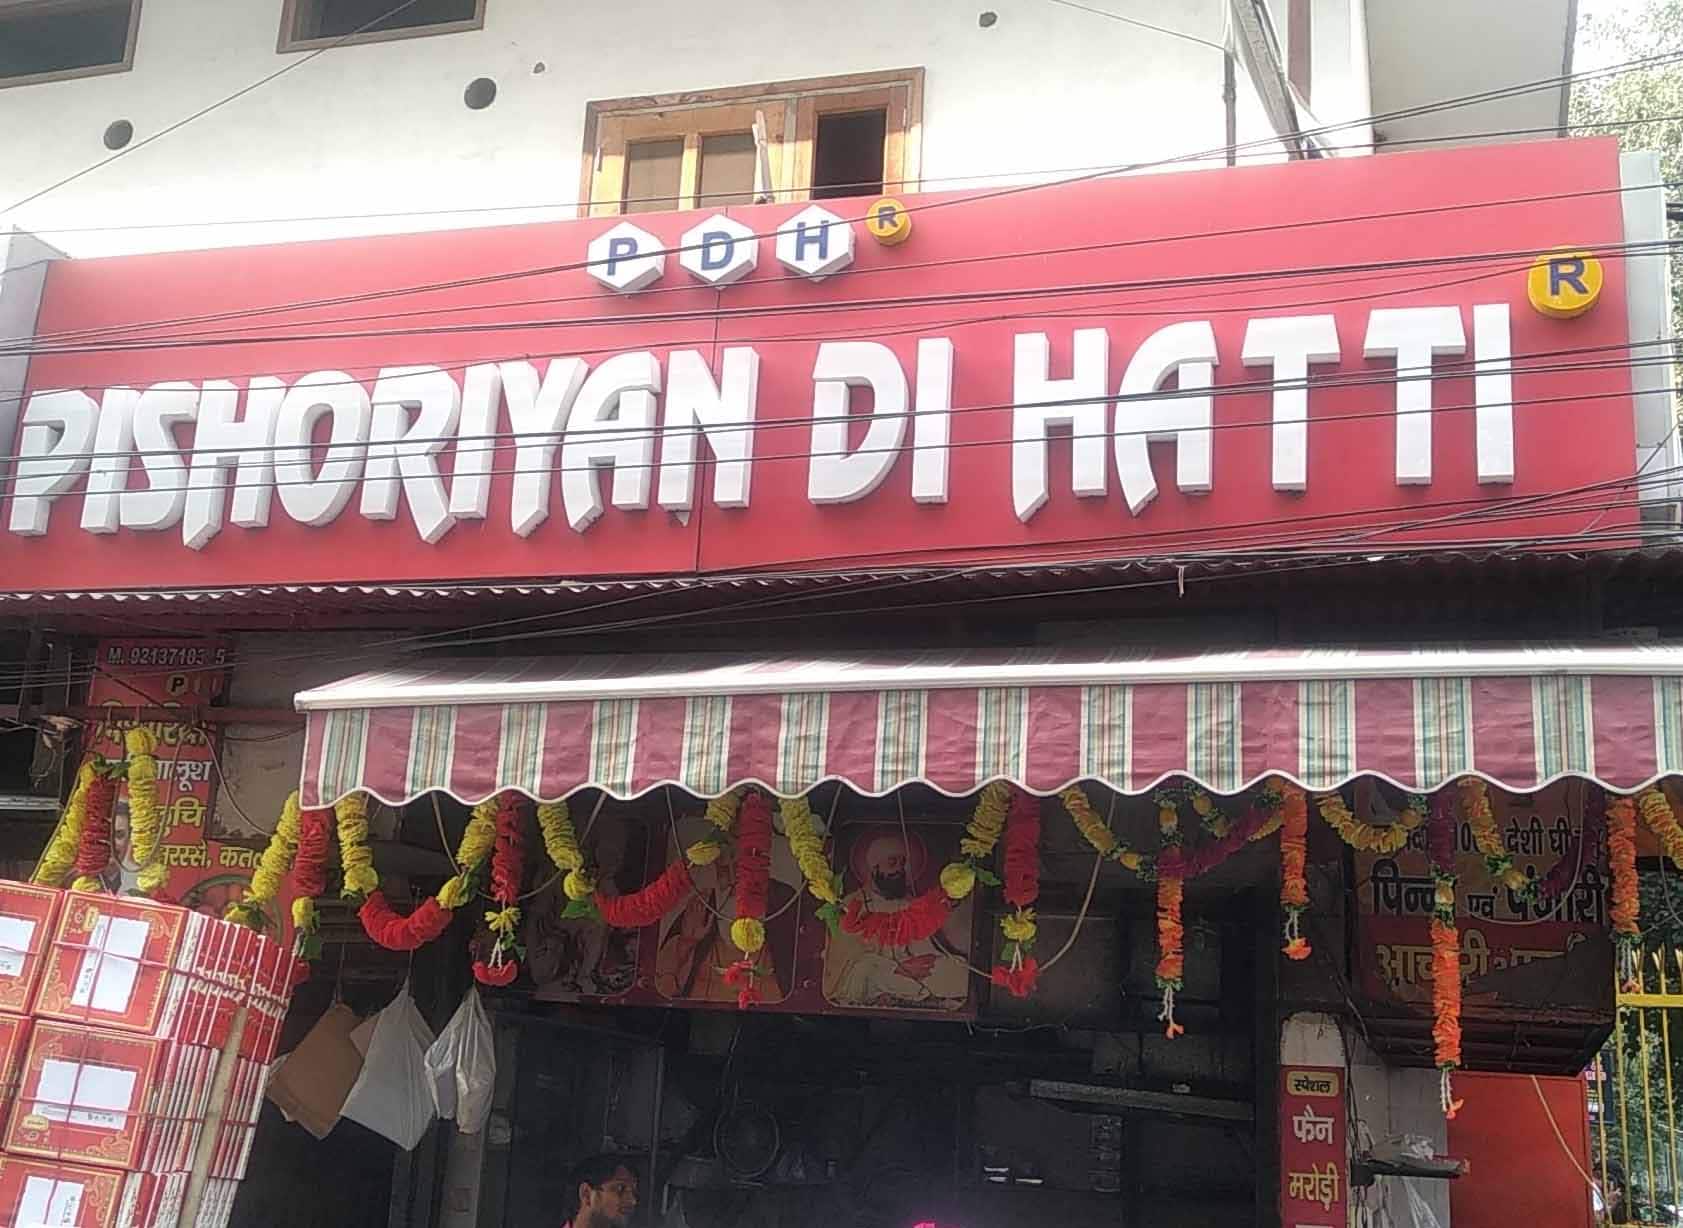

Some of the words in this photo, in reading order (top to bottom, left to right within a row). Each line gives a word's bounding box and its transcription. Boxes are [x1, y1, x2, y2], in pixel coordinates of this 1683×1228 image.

[9, 347, 761, 551] PISHORIYAN
[808, 337, 953, 510] DI
[1011, 303, 1516, 524] HATTI
[1549, 256, 1589, 297] R
[1294, 1075, 1331, 1093] स्पेशल
[1292, 1104, 1335, 1145] फैन
[1288, 1161, 1340, 1211] मरोड़ी
